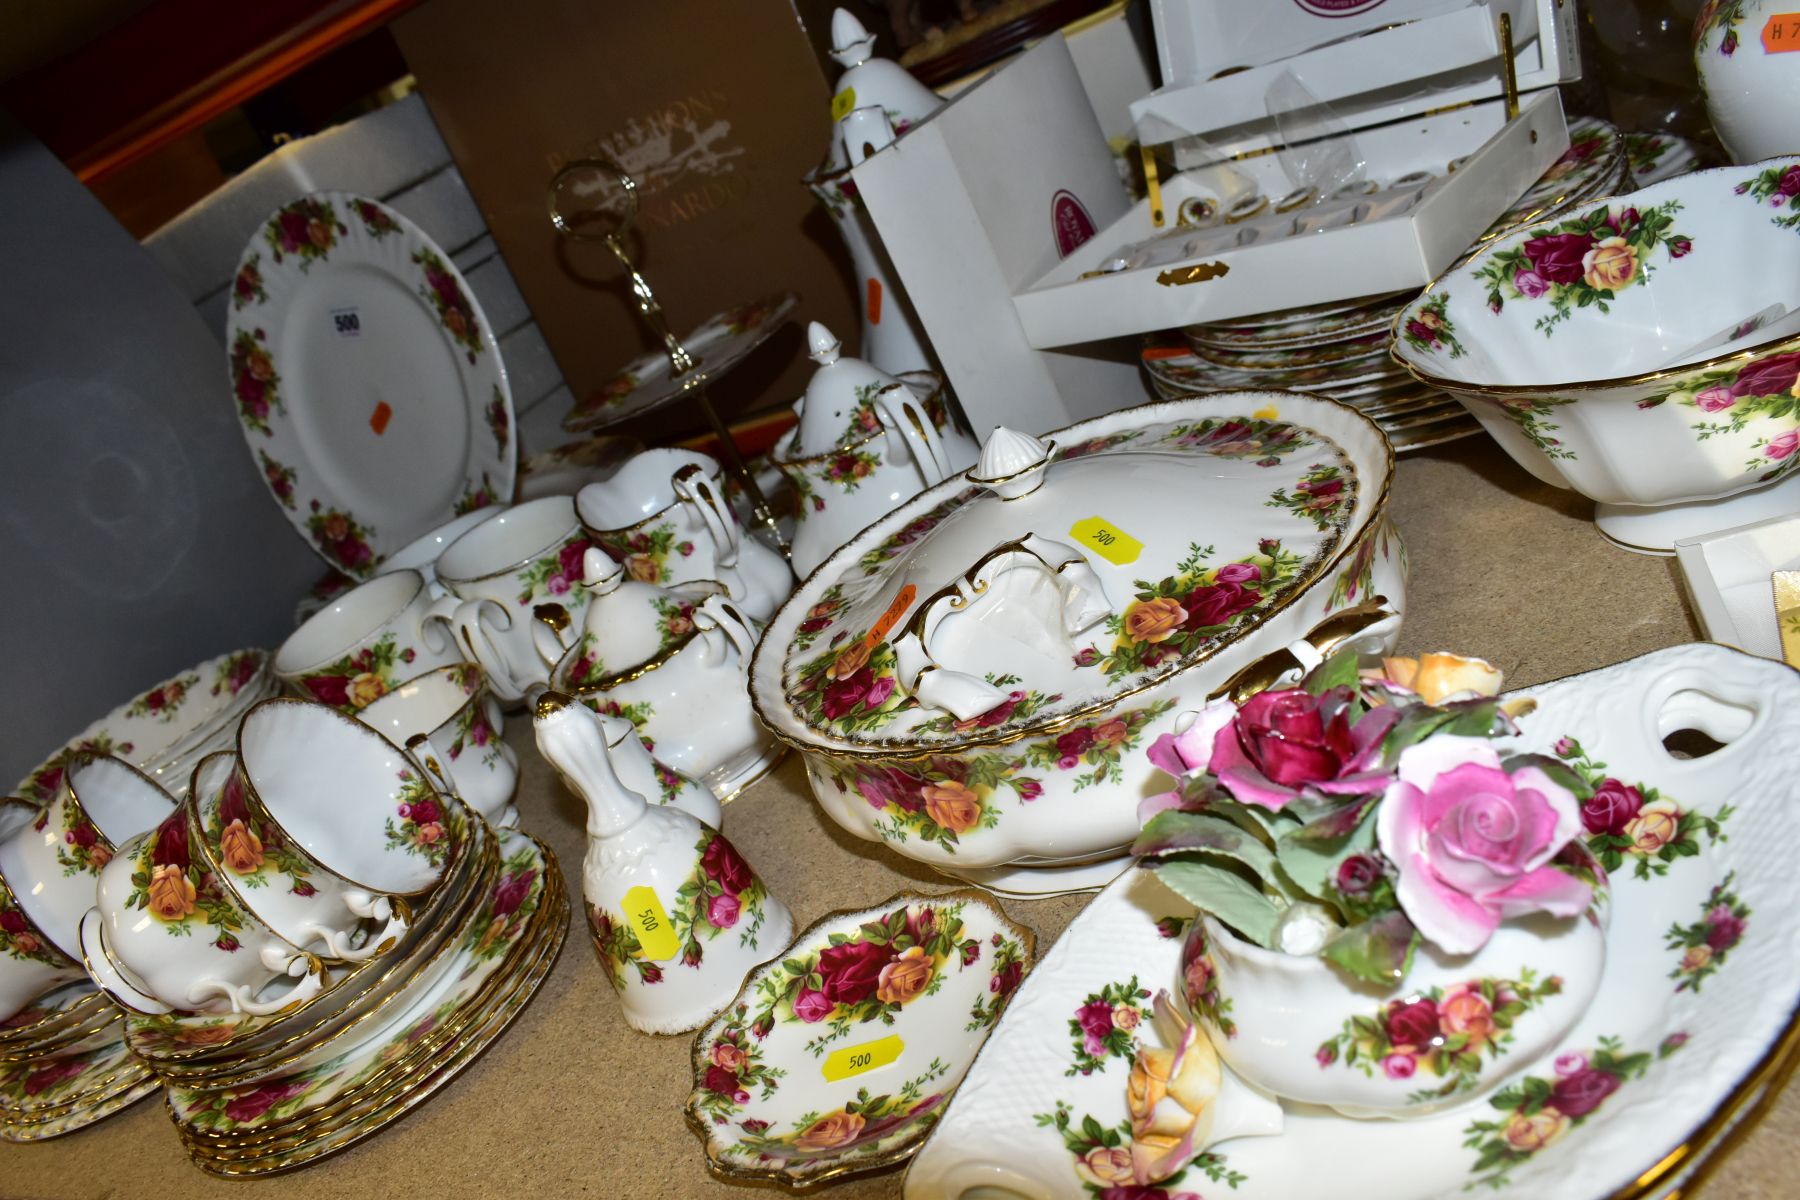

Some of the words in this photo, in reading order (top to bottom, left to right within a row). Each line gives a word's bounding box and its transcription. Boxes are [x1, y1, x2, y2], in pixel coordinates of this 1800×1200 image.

[1771, 23, 1783, 40] H
[645, 176, 751, 227] NARDO
[334, 313, 360, 332] 500
[1092, 529, 1116, 546] 500
[638, 908, 659, 932] 500
[849, 1052, 871, 1070] 500
